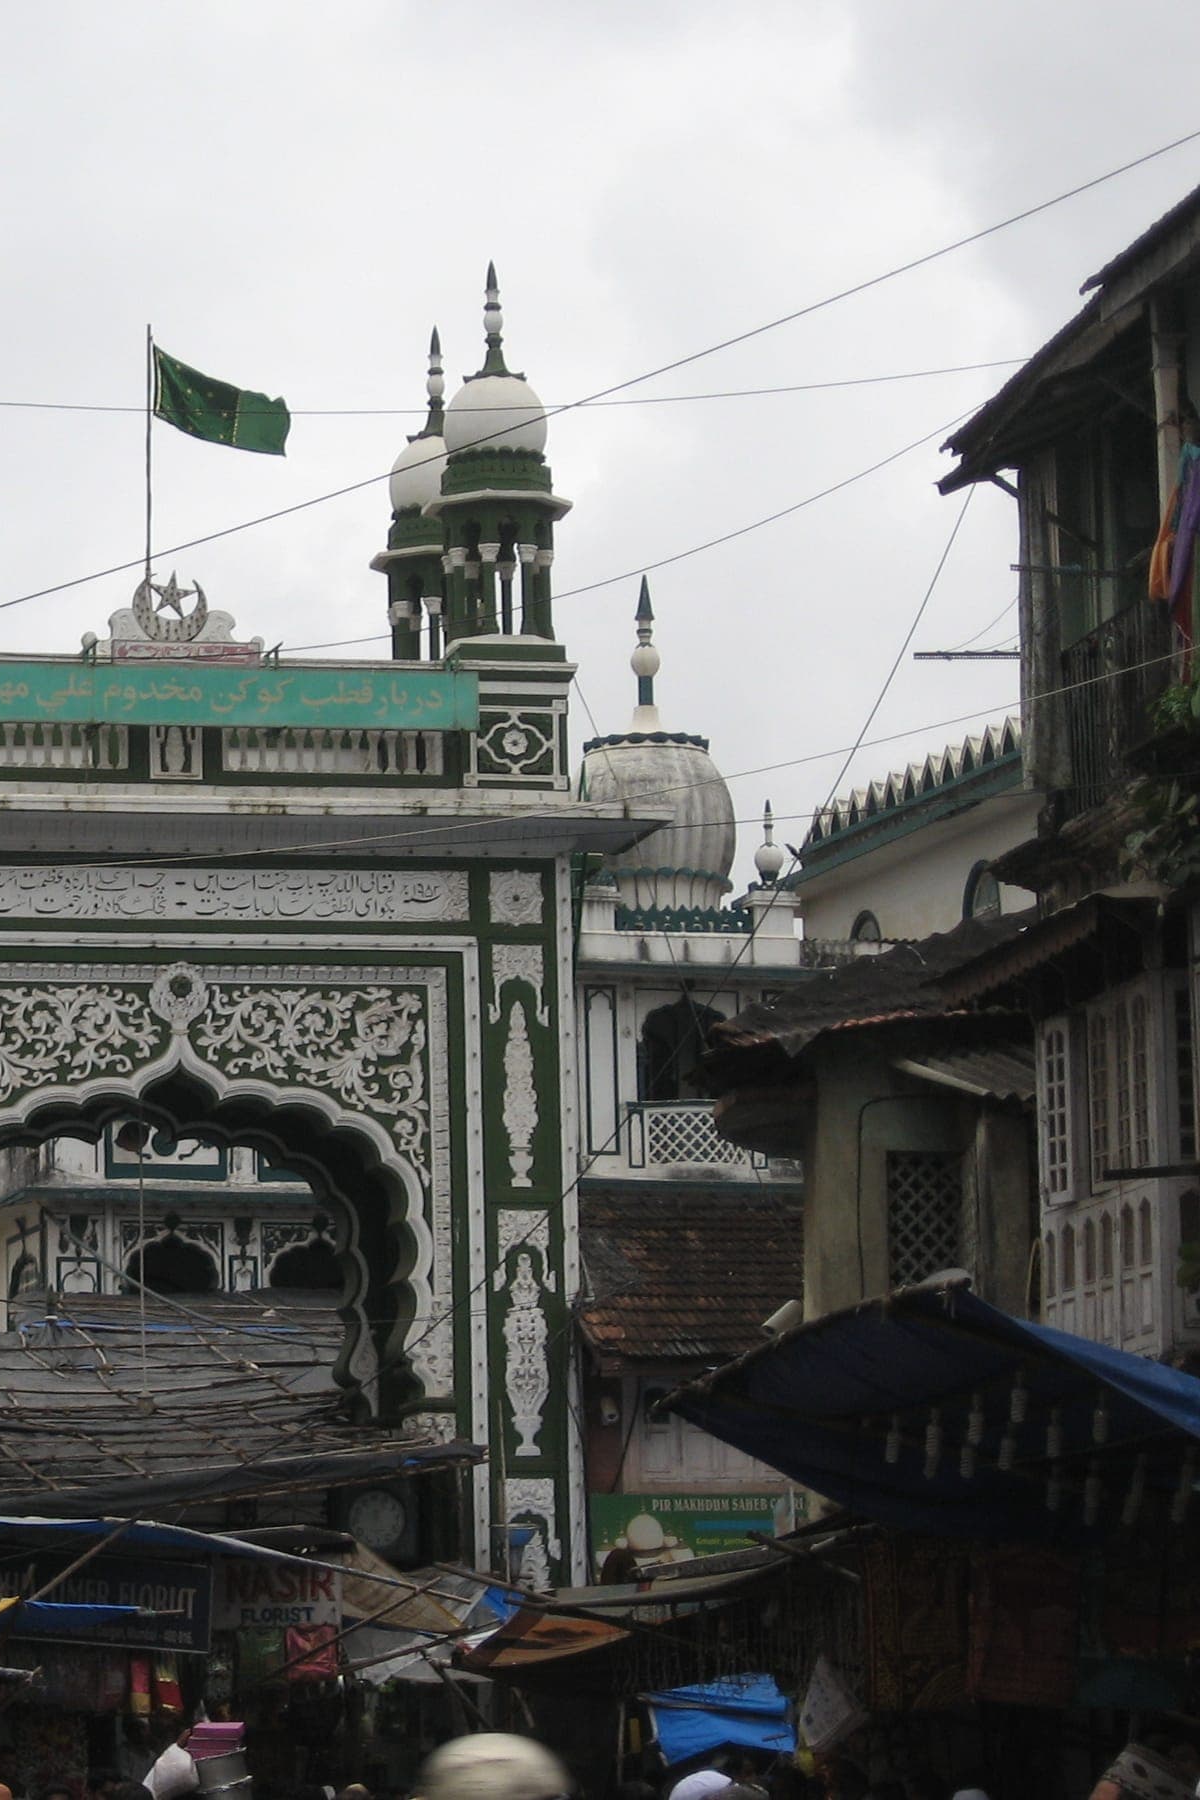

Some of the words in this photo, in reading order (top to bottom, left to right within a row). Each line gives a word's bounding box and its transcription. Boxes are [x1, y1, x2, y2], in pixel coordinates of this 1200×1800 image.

[103, 675, 203, 711] مخدوم
[300, 678, 373, 712] قطب
[651, 1498, 672, 1512] PIR
[673, 1498, 730, 1512] MAKHDUM
[731, 1497, 768, 1511] SAHEB
[224, 1565, 337, 1603] NASIR
[239, 1605, 315, 1624] FLORIST
